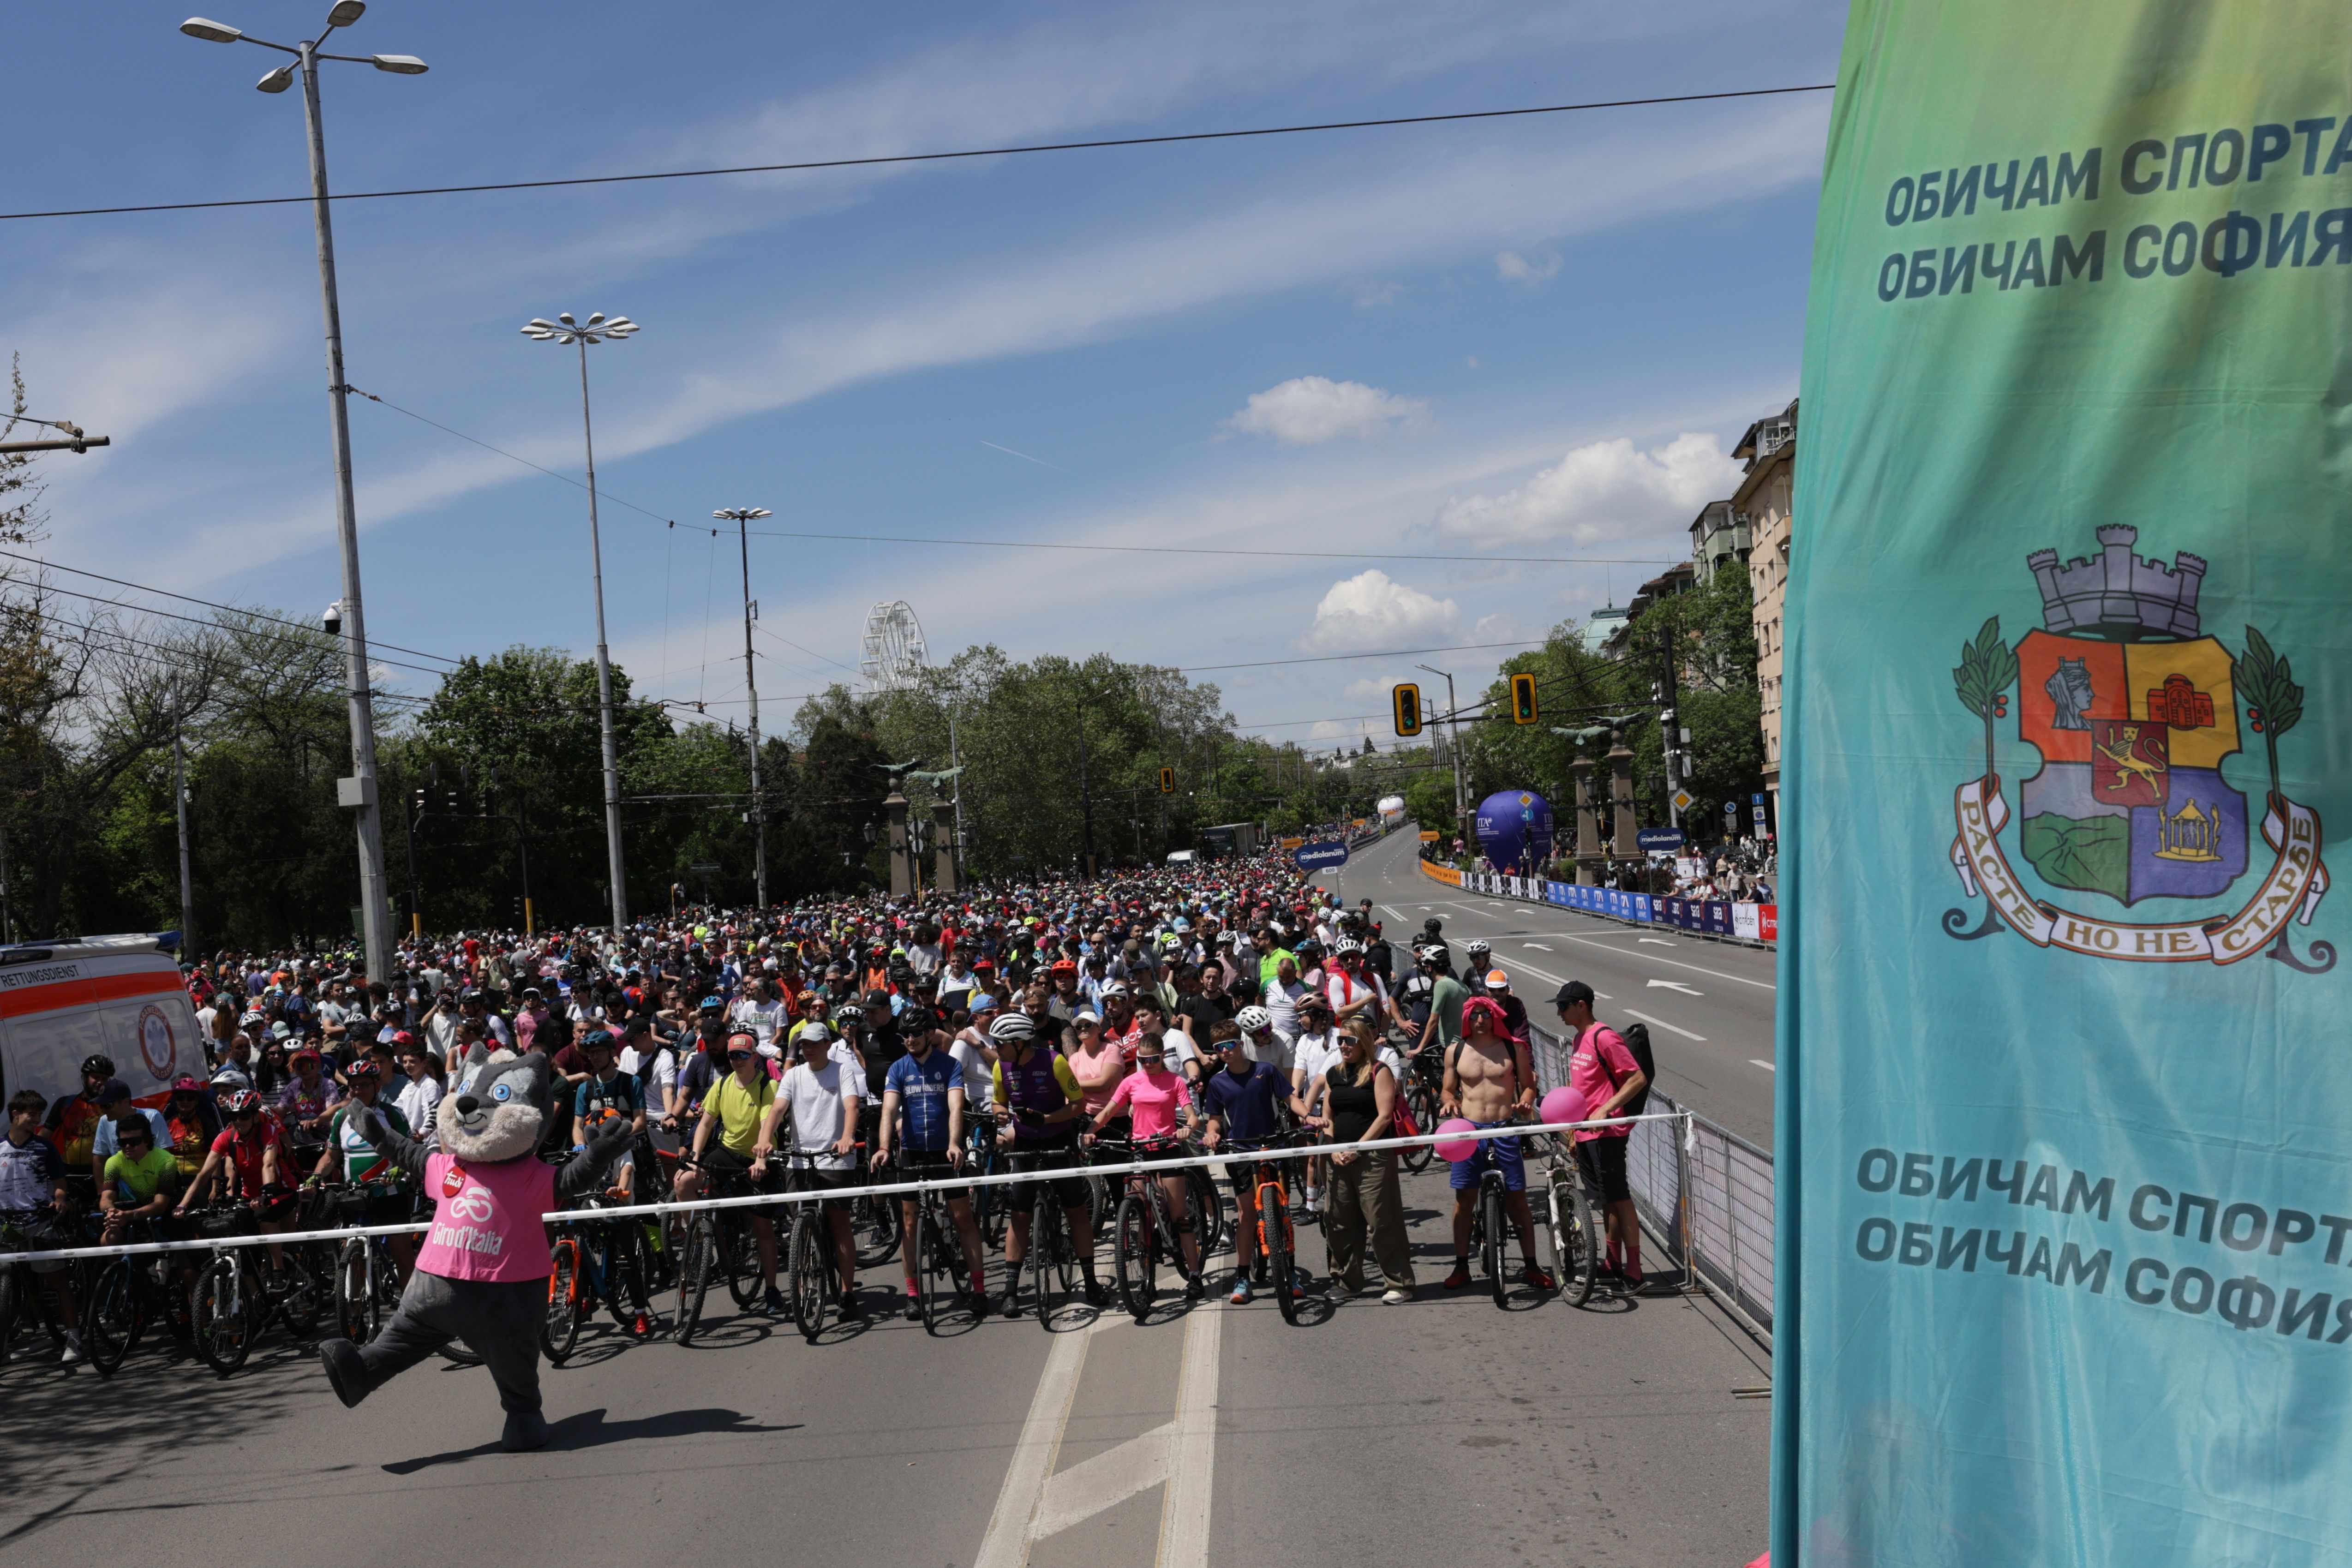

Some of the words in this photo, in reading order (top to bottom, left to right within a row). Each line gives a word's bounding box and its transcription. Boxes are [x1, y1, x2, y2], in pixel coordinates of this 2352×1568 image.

[1885, 148, 2103, 227] ОБИЧАМ
[1877, 230, 2107, 303] ОБИЧАМ
[2123, 208, 2352, 279] СОФИЯ
[1301, 850, 1345, 860] mediolanum
[1961, 800, 2036, 930] РАСТЕ
[2065, 920, 2119, 950] НО
[2135, 931, 2199, 954] НЕ
[1653, 899, 1662, 911] sara
[1713, 906, 1722, 920] sara
[0, 965, 79, 987] RETTUNGSDIENST
[139, 1004, 168, 1030] PARAMEDICS
[150, 1061, 174, 1078] BULGARIA
[905, 1085, 922, 1095] SLOW
[922, 1083, 945, 1092] RIDERS
[1856, 1148, 2116, 1222] ОБИЧАМ
[2129, 1185, 2352, 1269] СПОРТ
[432, 1221, 452, 1246] Giro
[455, 1226, 503, 1256] d'Italia
[1855, 1217, 2112, 1294] ОБИЧАМ
